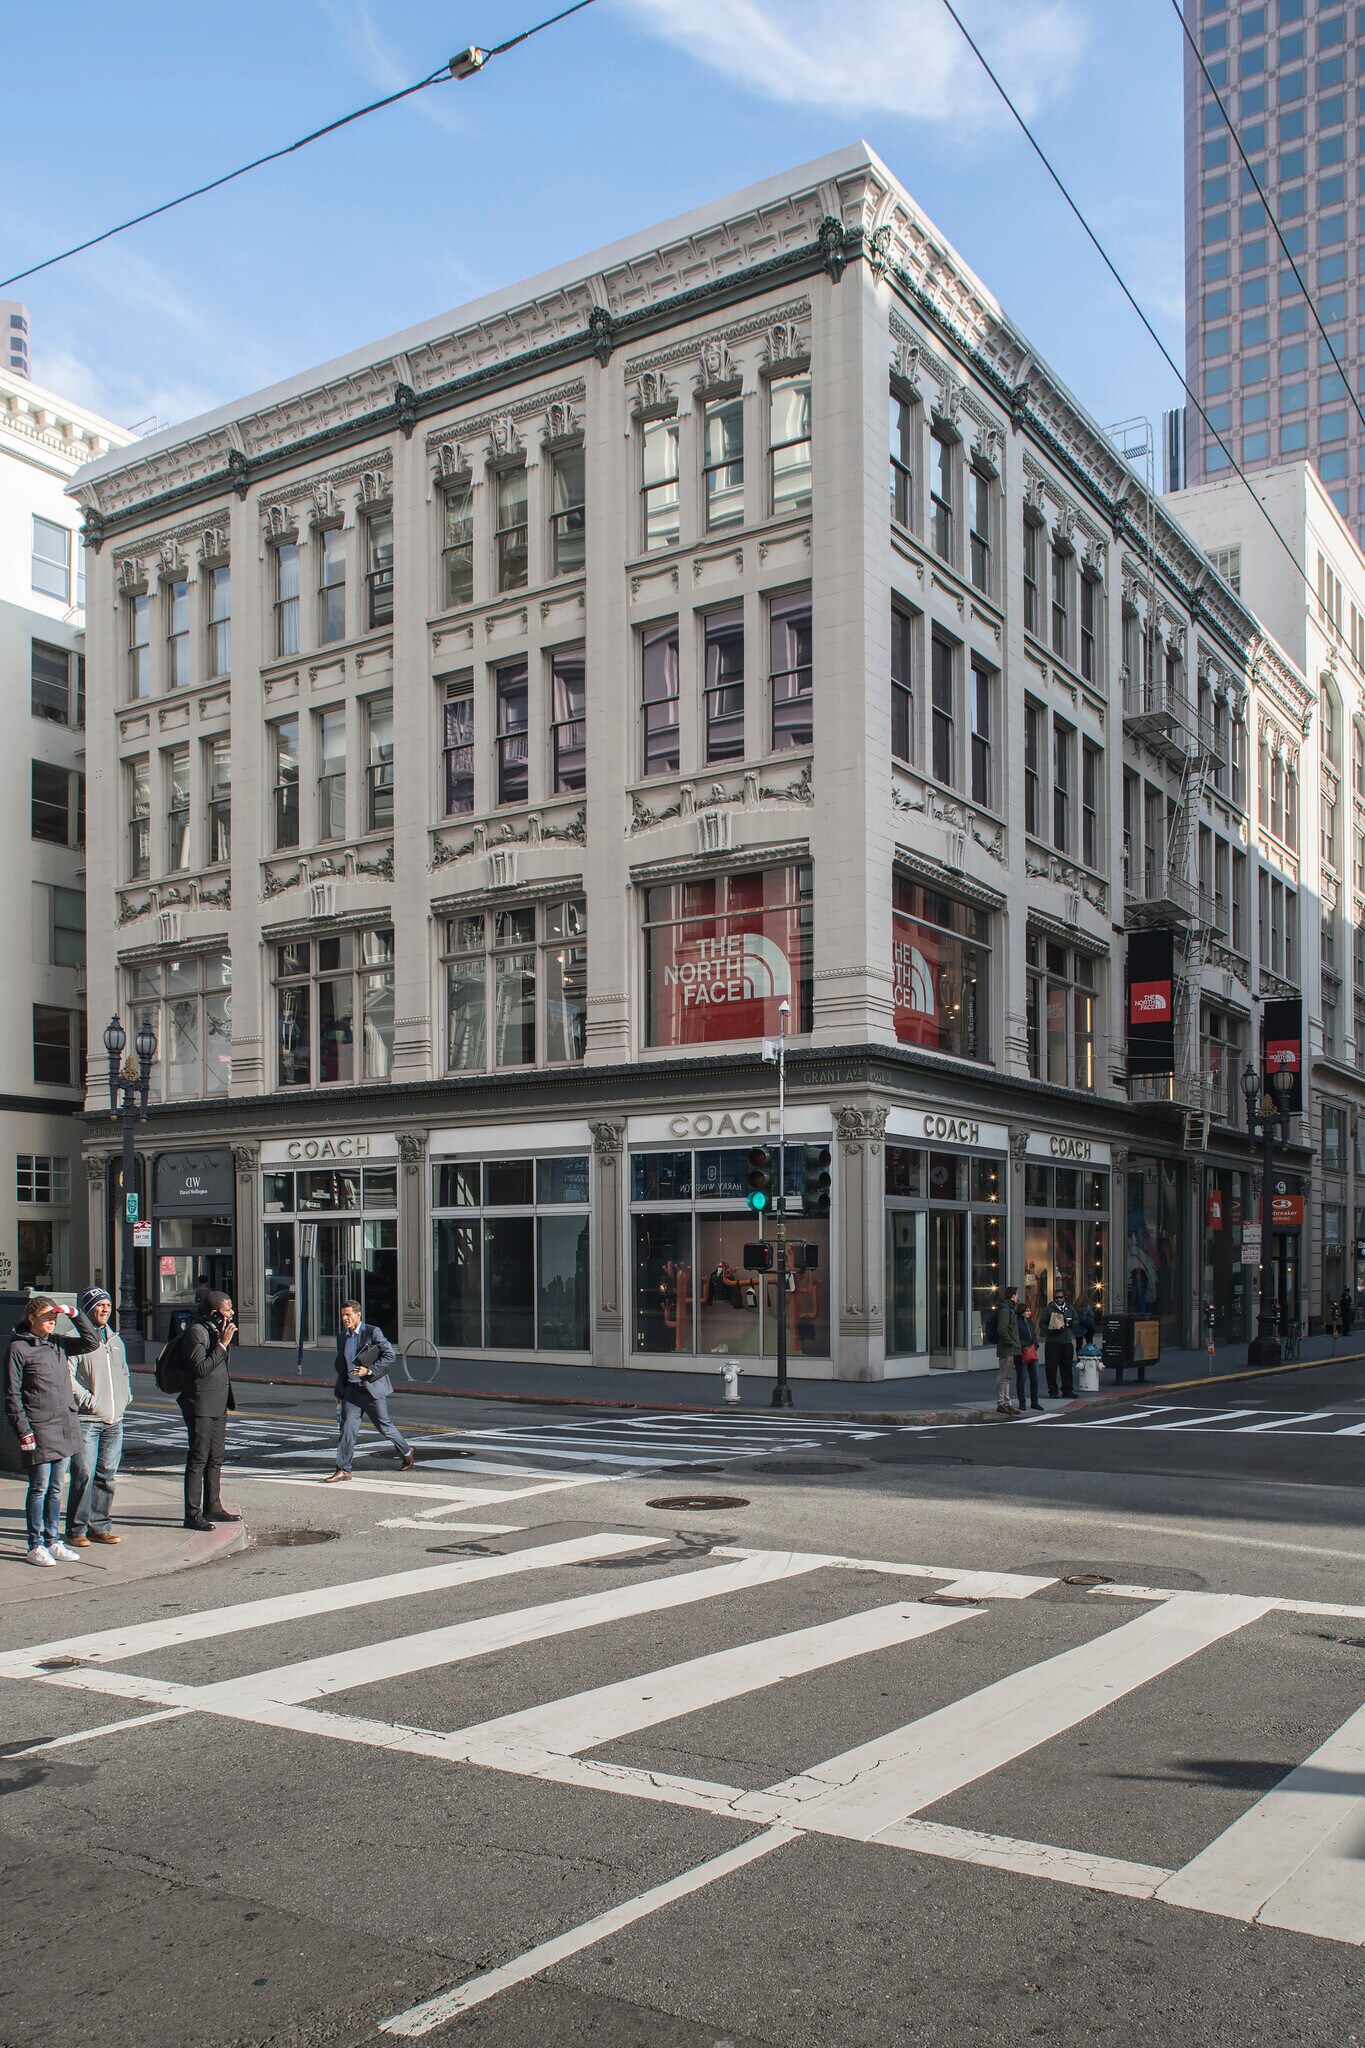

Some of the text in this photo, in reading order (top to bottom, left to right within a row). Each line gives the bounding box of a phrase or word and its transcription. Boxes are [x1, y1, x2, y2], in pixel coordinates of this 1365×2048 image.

[696, 934, 741, 959] THE
[894, 940, 911, 965] HE
[664, 957, 741, 986] NORTH
[683, 979, 741, 1006] FACE
[894, 985, 911, 1009] CE
[803, 1069, 842, 1084] GRANT
[669, 1110, 782, 1138] COACH
[923, 1114, 979, 1144] COACH
[287, 1136, 370, 1160] COACH
[1049, 1136, 1092, 1160] COACH
[191, 1188, 208, 1196] Wellington
